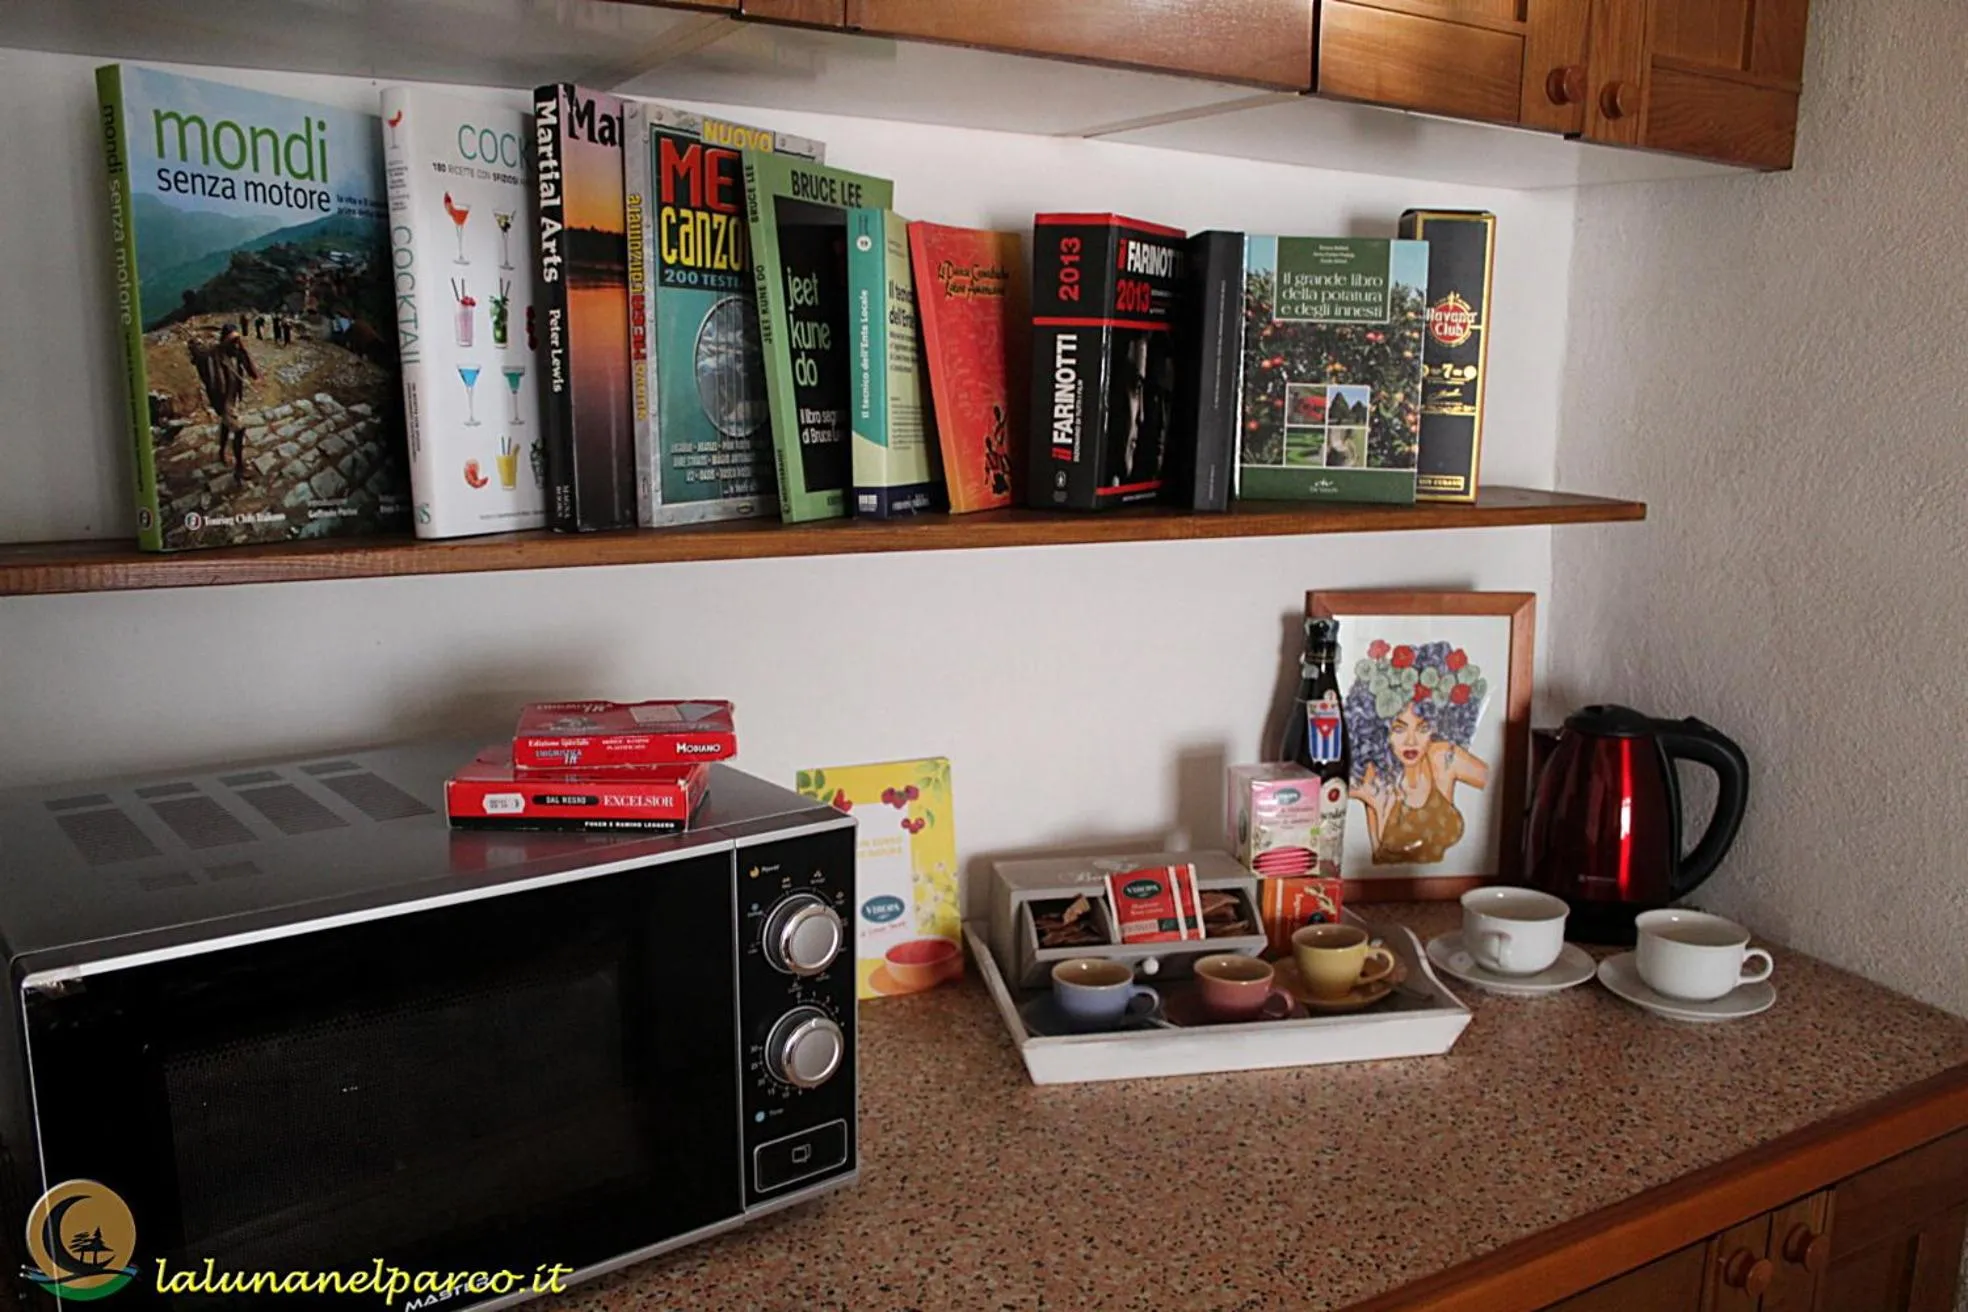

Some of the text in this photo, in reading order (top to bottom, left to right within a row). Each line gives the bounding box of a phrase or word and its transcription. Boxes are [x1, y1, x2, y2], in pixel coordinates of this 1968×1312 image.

[153, 109, 328, 183] mondi
[703, 117, 773, 153] NUOVO
[156, 168, 331, 212] senza motore
[535, 98, 564, 284] Martial Arts
[745, 164, 760, 224] BRUCE LEE
[791, 170, 863, 209] BRUCE LEE
[103, 104, 133, 326] mondi senza motore
[664, 268, 699, 285] 200
[1058, 236, 1082, 302] 2013
[1283, 271, 1384, 288] Il grande libro
[392, 226, 421, 364] COCKTAIL
[756, 264, 773, 345] JEET KUNE DO
[786, 266, 819, 311] jeet
[859, 289, 869, 322] Locale
[1115, 279, 1150, 314] 2013
[1282, 286, 1383, 304] della potatura
[1280, 301, 1383, 319] e degli innesti
[1426, 307, 1478, 323] Havana
[789, 313, 831, 350] kune
[1434, 322, 1464, 336] Club
[549, 309, 563, 393] Peter Lewis
[795, 352, 818, 387] do
[860, 372, 870, 409] tecnico
[1052, 333, 1078, 445] FARINOTTI
[676, 742, 721, 754] MODIANO
[546, 796, 587, 805] DAL NEGRO
[603, 794, 674, 808] EXCELSIOR
[616, 821, 642, 829] RAMINO
